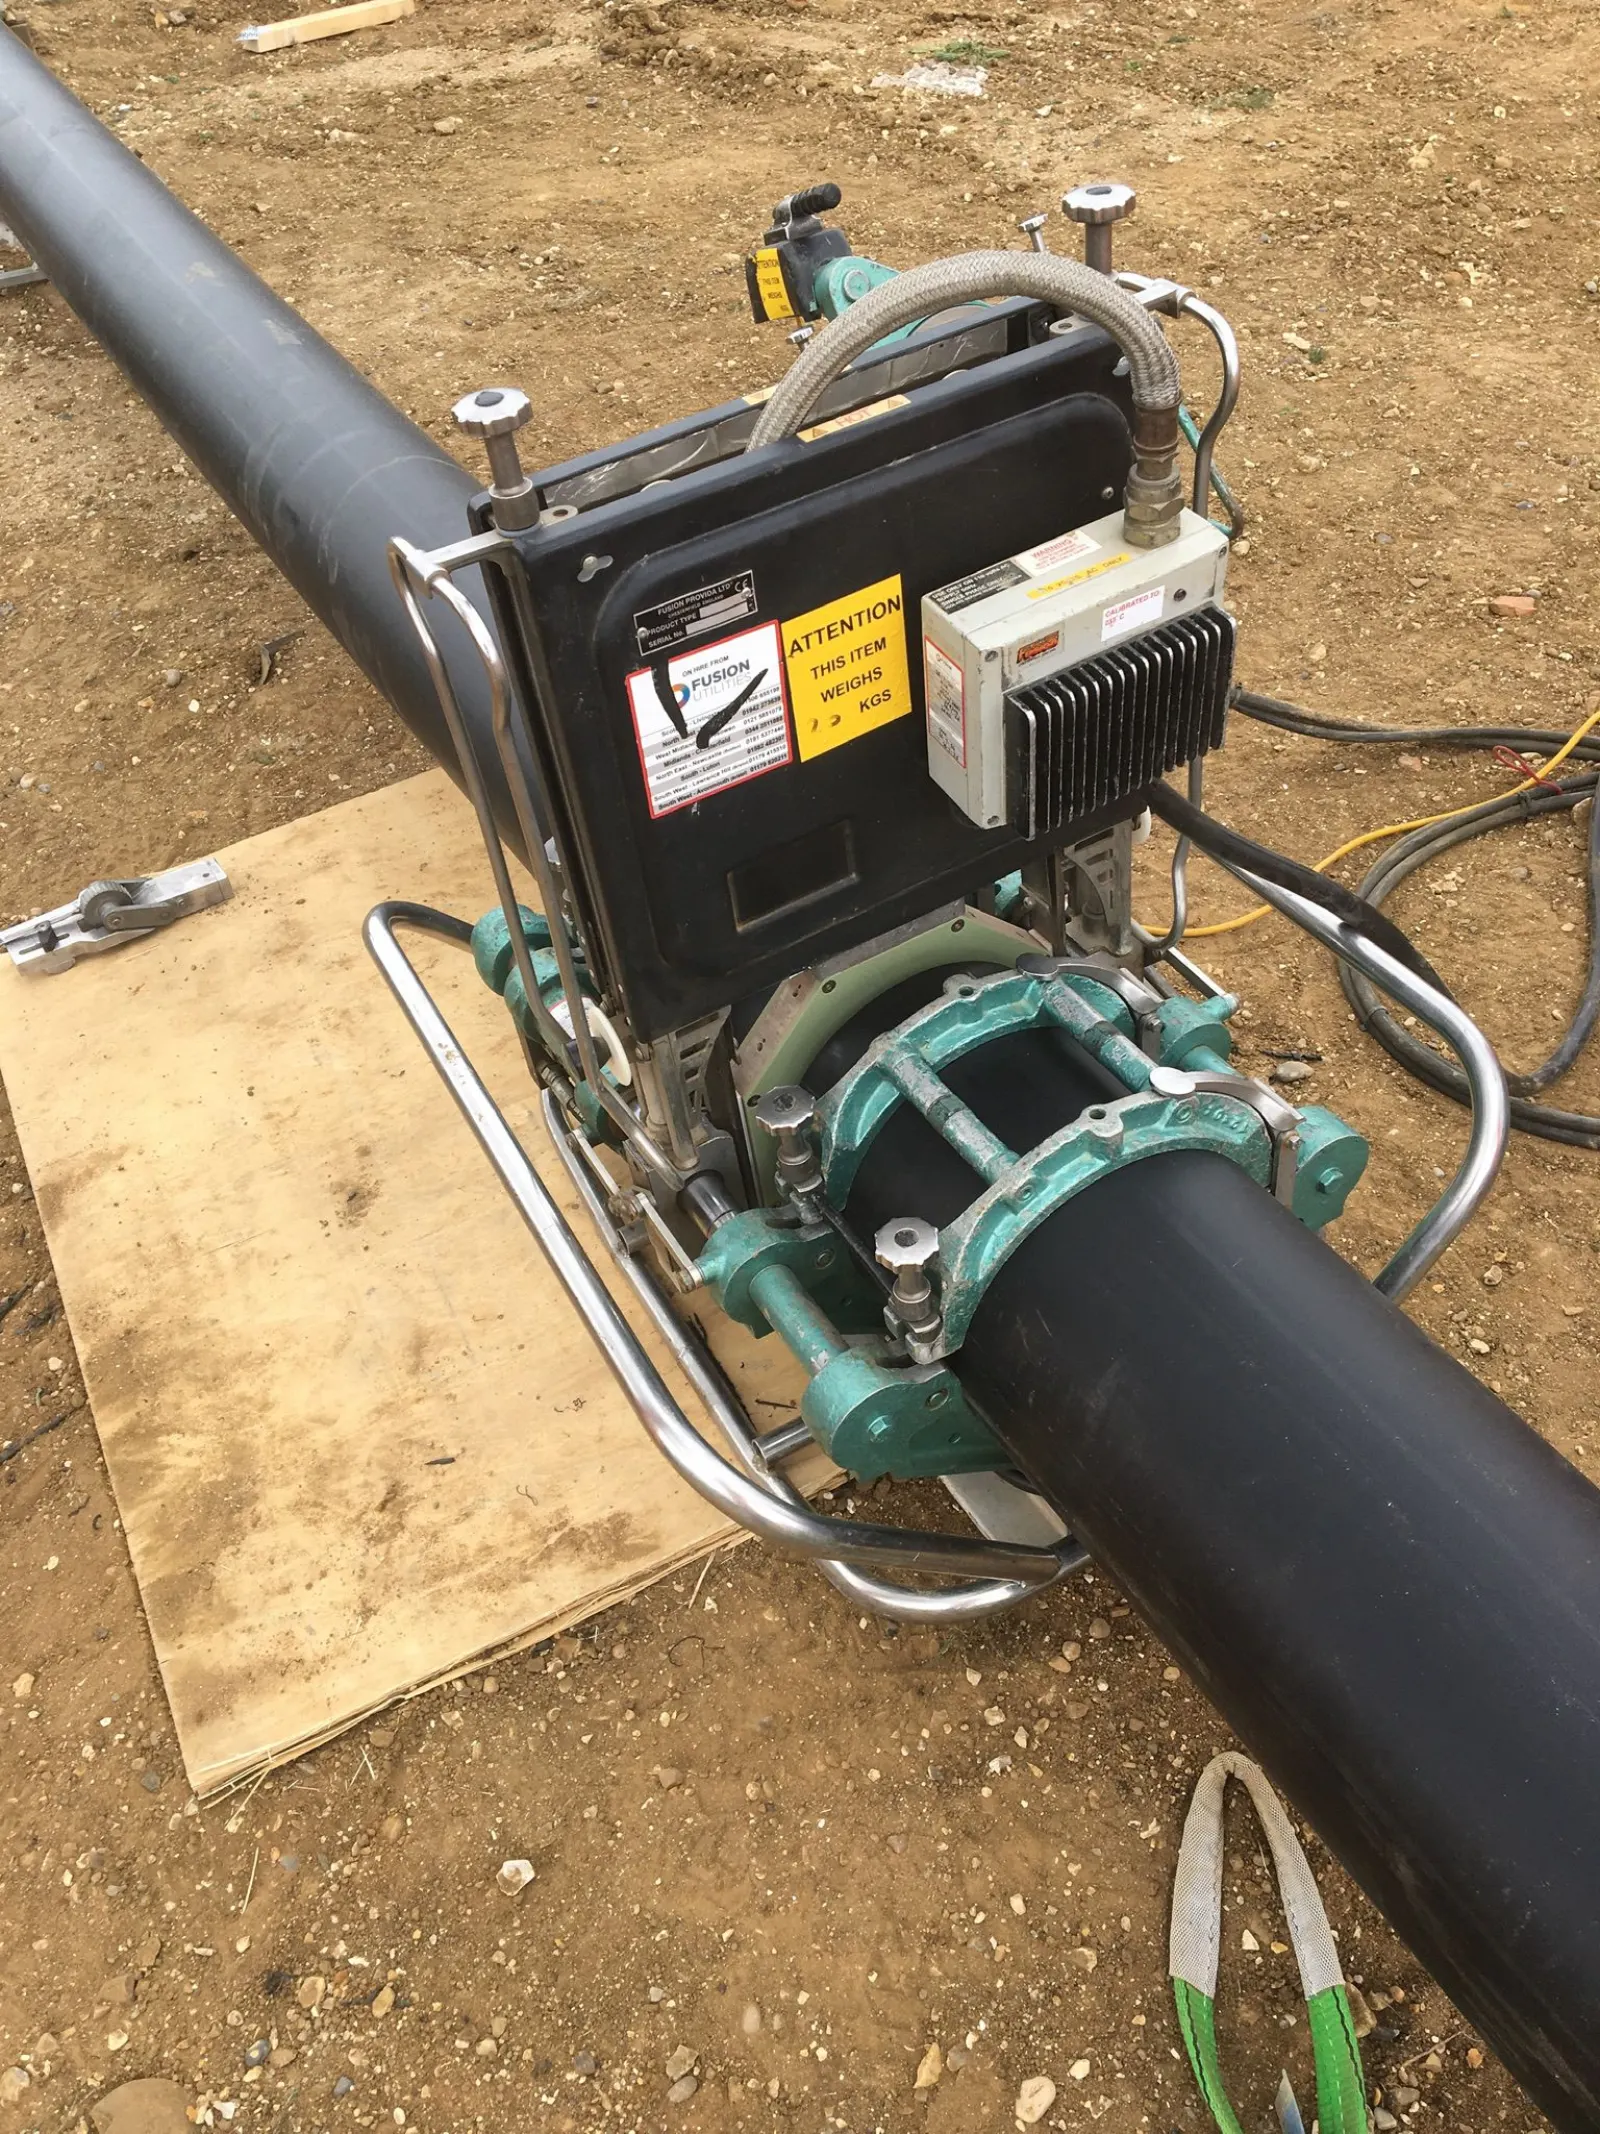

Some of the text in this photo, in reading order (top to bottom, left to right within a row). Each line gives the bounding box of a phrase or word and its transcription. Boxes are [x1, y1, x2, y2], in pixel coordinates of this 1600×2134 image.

[836, 409, 872, 426] HOT
[658, 600, 684, 615] FUSION
[686, 590, 717, 603] PROVIDA
[1105, 595, 1148, 617] CALIBRATED
[648, 613, 697, 635] PRODUCT TYPE
[788, 595, 901, 658] ATTENTION
[649, 635, 672, 647] SERIAL
[682, 654, 728, 677] ON HIRE FROM
[810, 637, 886, 680] THIS ITEM
[691, 658, 750, 691] FUSION
[821, 666, 882, 702] WEIGHS
[693, 671, 751, 702] UTILITIES
[859, 689, 891, 713] KGS
[743, 715, 756, 725] 0121
[662, 736, 679, 747] North
[656, 770, 673, 781] North
[674, 764, 687, 773] East
[692, 750, 721, 766] Newcastle
[664, 752, 690, 768] Midlands
[680, 770, 698, 781] South
[703, 761, 719, 772] Luton
[654, 790, 671, 802] South
[672, 784, 687, 794] West
[692, 771, 719, 786] Lawrence
[658, 798, 677, 810] South
[678, 792, 692, 802] West
